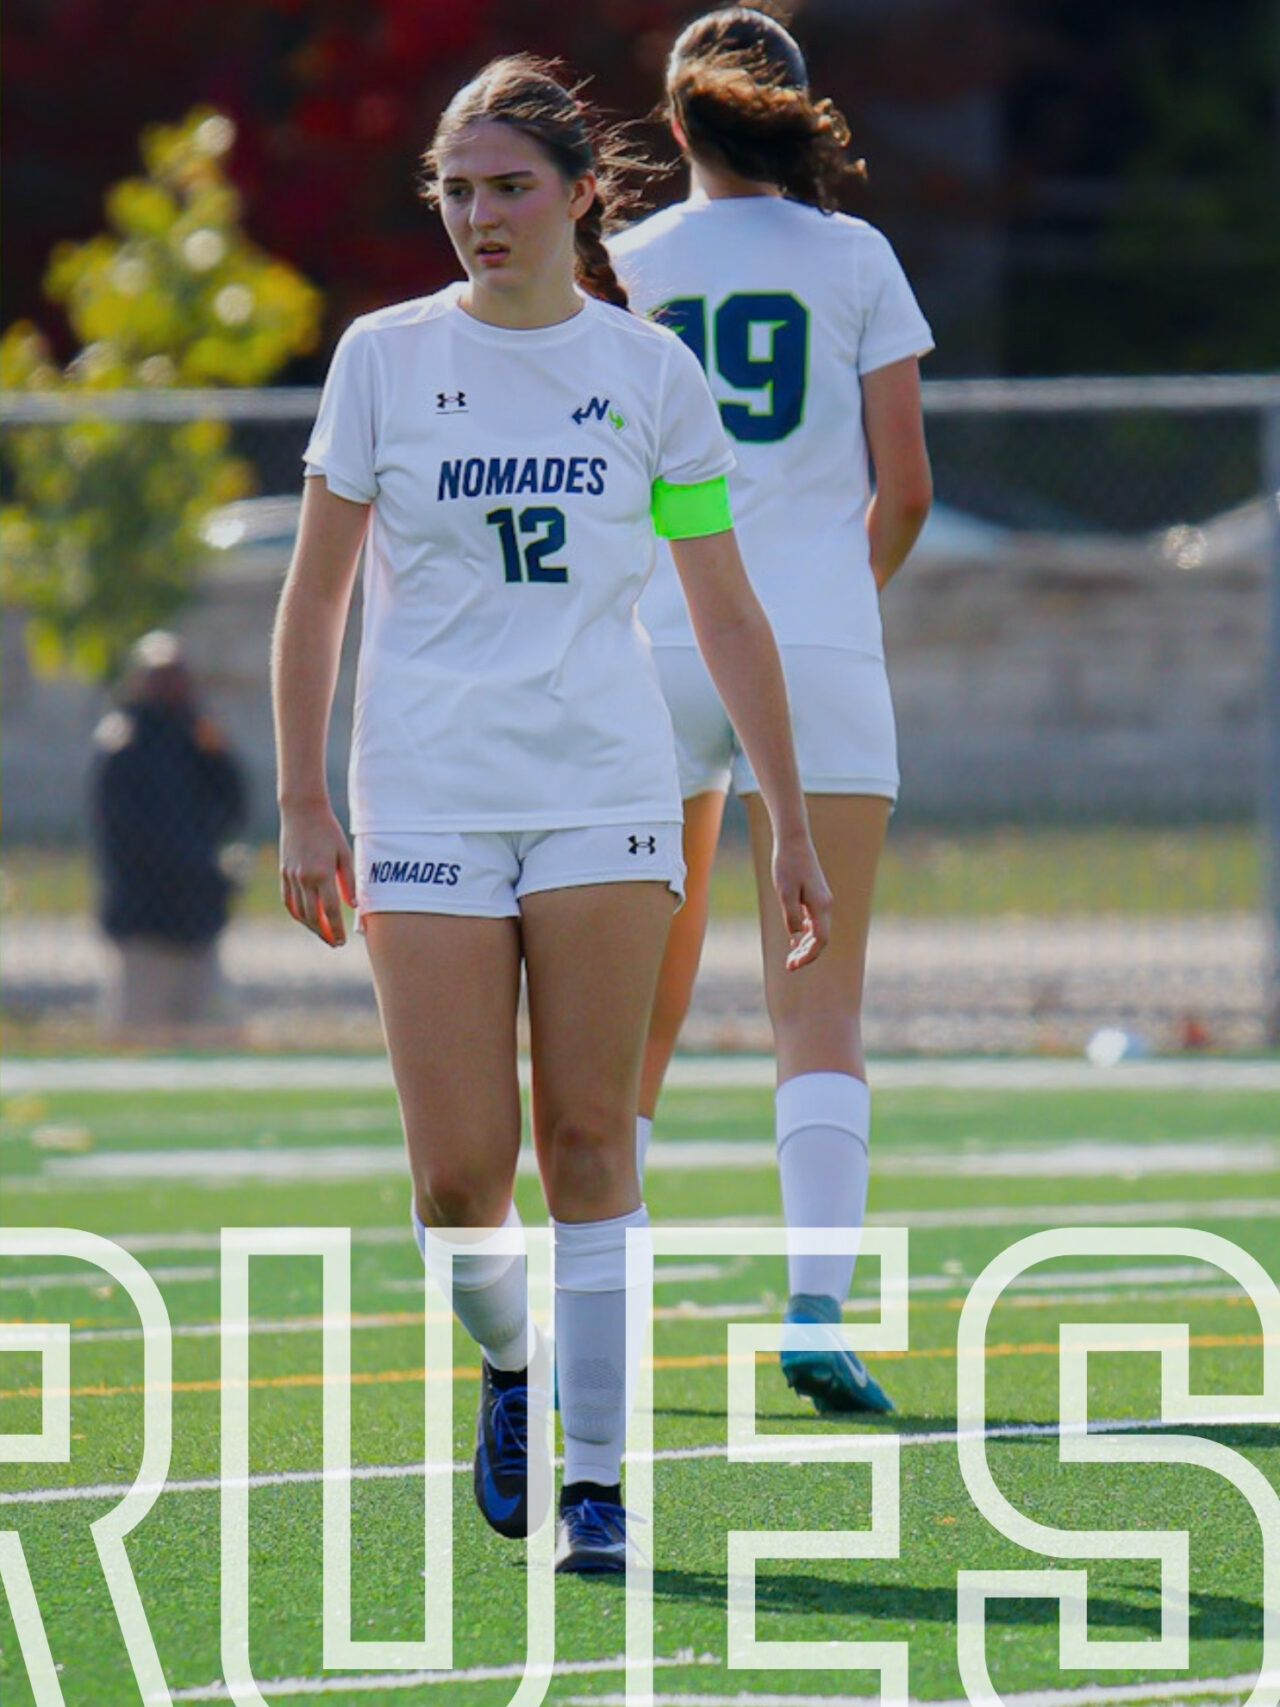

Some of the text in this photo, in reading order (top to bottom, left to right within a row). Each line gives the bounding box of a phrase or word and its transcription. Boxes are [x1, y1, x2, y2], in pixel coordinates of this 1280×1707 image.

[437, 456, 607, 501] NOMADES
[485, 506, 568, 583] 12
[369, 861, 461, 886] NOMADES
